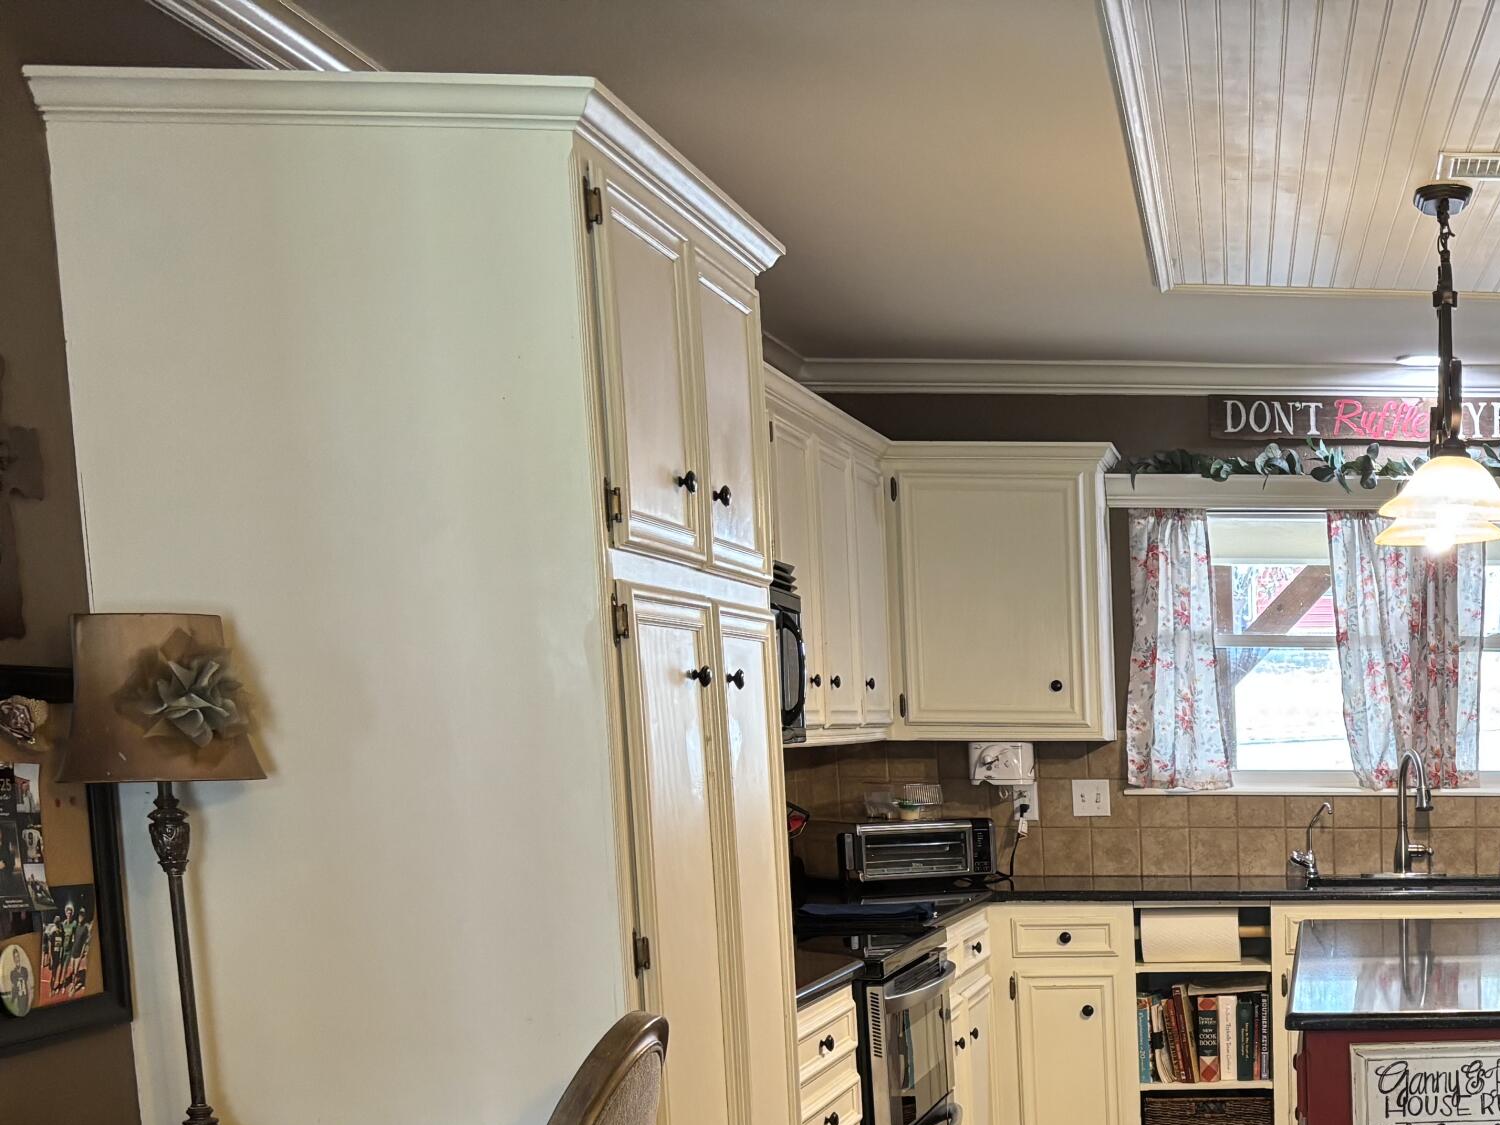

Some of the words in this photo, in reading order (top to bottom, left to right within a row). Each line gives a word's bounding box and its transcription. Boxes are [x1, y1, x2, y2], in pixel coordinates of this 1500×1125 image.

[1224, 400, 1323, 436] DON'T
[1333, 398, 1429, 438] Ruffle
[1457, 402, 1487, 440] Y
[1461, 1060, 1485, 1095] &
[1385, 1095, 1472, 1119] HOUSE
